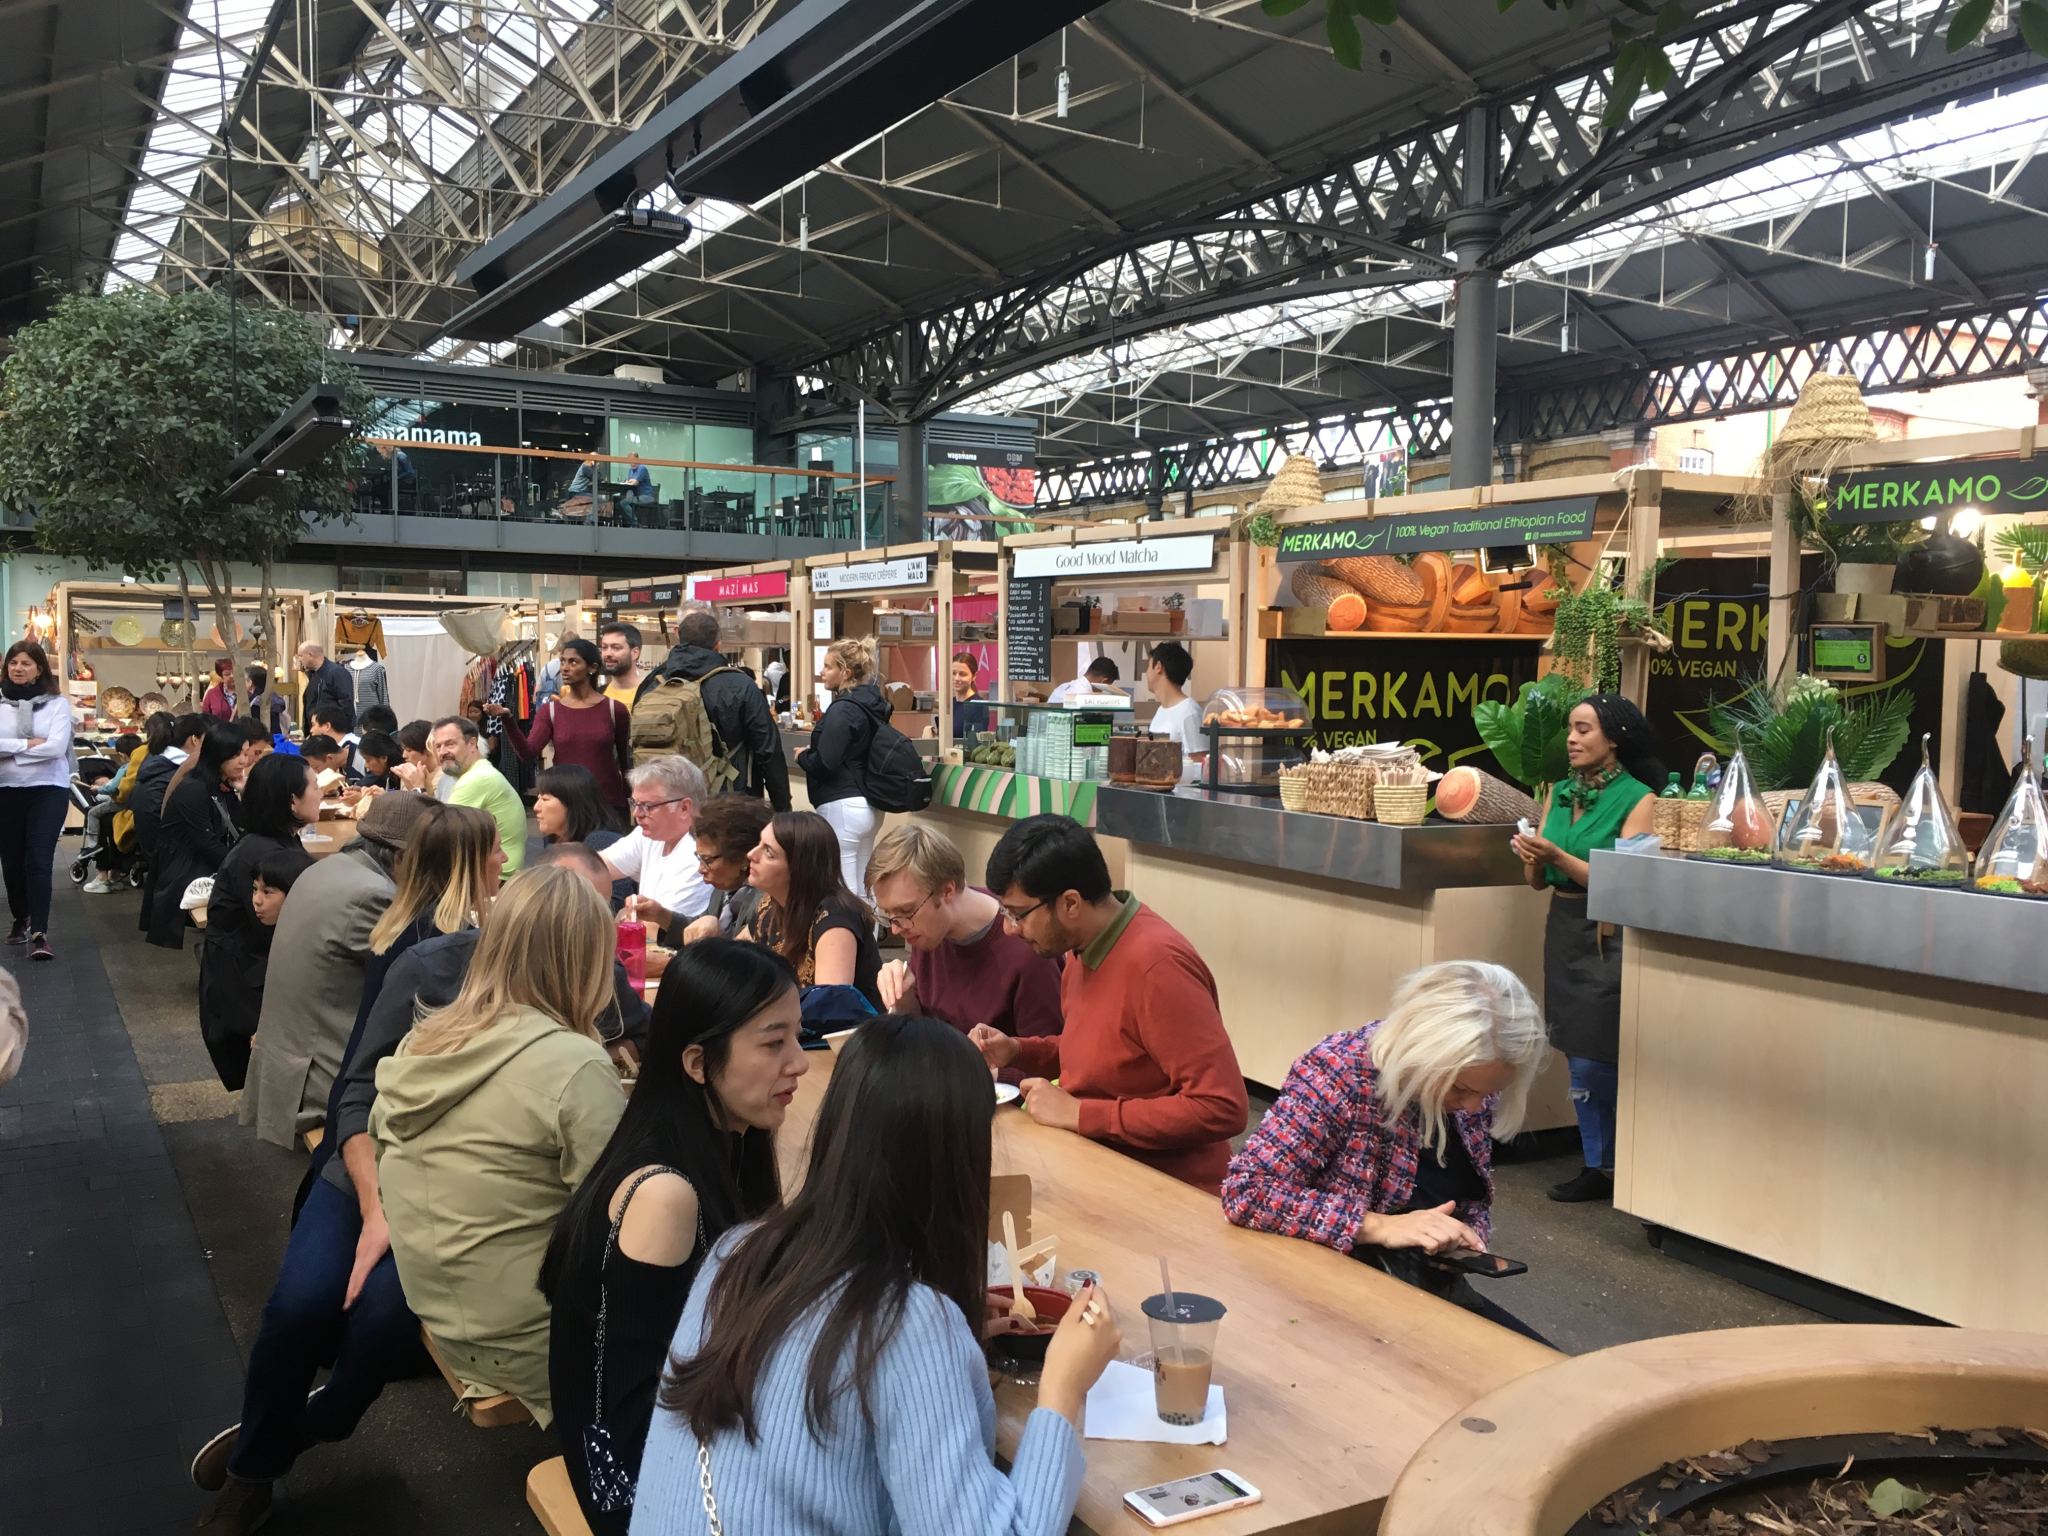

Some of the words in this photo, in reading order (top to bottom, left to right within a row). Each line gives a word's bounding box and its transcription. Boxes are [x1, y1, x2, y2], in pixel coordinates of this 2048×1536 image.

[1837, 474, 2001, 511] MERKAMO
[1395, 525, 1417, 538] 100%
[1419, 524, 1449, 538] Vegan
[1452, 518, 1502, 533] Traditional
[1504, 514, 1555, 530] Ethiopian
[1557, 510, 1587, 525] Food
[1282, 530, 1357, 552] MERKAMO
[907, 561, 923, 571] L'AMI
[1056, 552, 1084, 568] Good
[1087, 549, 1116, 566] Mood
[1119, 547, 1158, 564] Matcha
[814, 571, 829, 580] L'AMI
[815, 580, 830, 588] MALO
[839, 572, 859, 583] MODERN
[860, 571, 876, 581] FRENCH
[907, 570, 924, 580] MALO
[742, 581, 759, 594] MAS
[1677, 660, 1737, 678] VEGAN
[1281, 670, 1510, 720] MERKAMO
[1323, 729, 1377, 748] VEGAN
